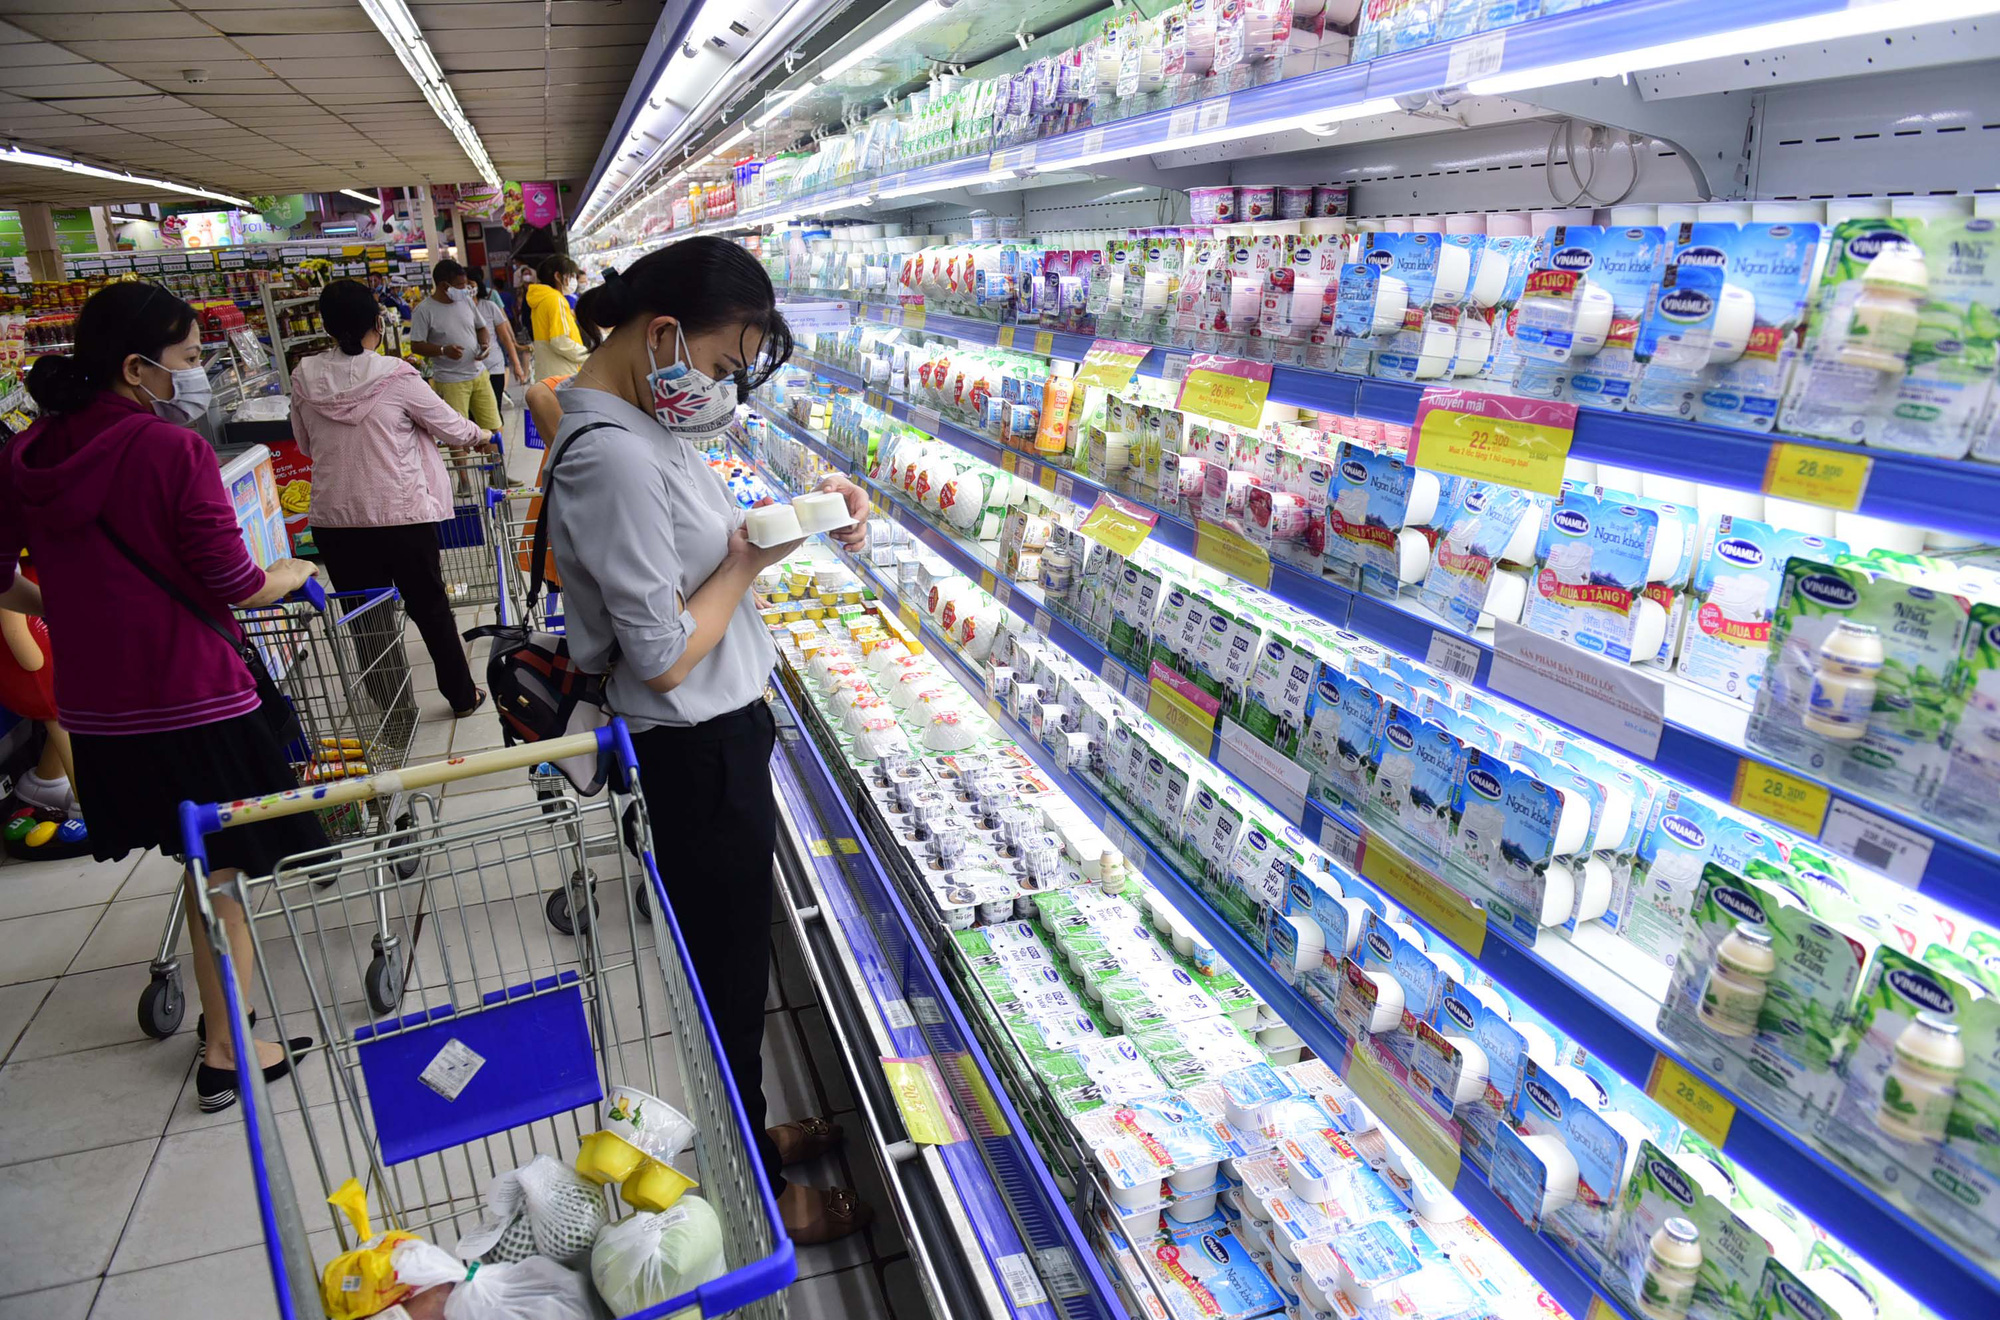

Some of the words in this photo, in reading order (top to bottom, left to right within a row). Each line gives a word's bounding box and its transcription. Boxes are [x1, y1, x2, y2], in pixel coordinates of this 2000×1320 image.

[1320, 254, 1336, 271] Dâu
[1555, 256, 1592, 268] VINAMILK
[1663, 299, 1710, 313] VINAMILK
[1344, 464, 1367, 480] VINAMILK
[1555, 514, 1589, 531] VINAMILK
[1593, 525, 1621, 543] Ngon
[1720, 542, 1763, 562] VINAMILK
[1561, 586, 1579, 600] MUA
[1581, 588, 1588, 599] 8
[1590, 586, 1620, 603] TẶNG
[1803, 579, 1857, 601] VINAMILK
[1726, 622, 1751, 638] MUA
[1754, 627, 1762, 638] 8
[1228, 648, 1239, 660] Sữa
[1233, 639, 1247, 651] 100%
[1226, 658, 1241, 673] Tươi
[1292, 667, 1308, 683] 100%
[1576, 670, 1598, 684] THEO
[1287, 679, 1299, 692] Sữa
[1320, 684, 1339, 702] VINAMILK
[1284, 689, 1301, 706] Tươi
[1389, 728, 1413, 747] VINAMILK
[1415, 744, 1435, 764] Ngon
[1470, 772, 1500, 796] VINAMILK
[1504, 794, 1530, 816] Ngon
[1218, 818, 1232, 833] 100%
[1664, 818, 1704, 846] VINAMILK
[1211, 836, 1226, 854] Tươi
[1709, 843, 1741, 870] Ngon
[1266, 870, 1278, 884] Sữa
[1263, 879, 1279, 897] Tươi
[1717, 890, 1763, 921] VINAMILK
[1369, 935, 1391, 958] VINAMILK
[1893, 972, 1951, 1011] VINAMILK
[1446, 1000, 1473, 1027] VINAMILK
[1528, 1083, 1561, 1118] VINAMILK
[1653, 1163, 1694, 1203] VINAMILK
[1204, 1236, 1228, 1263] VINAMILK
[1170, 1263, 1186, 1281] MUA
